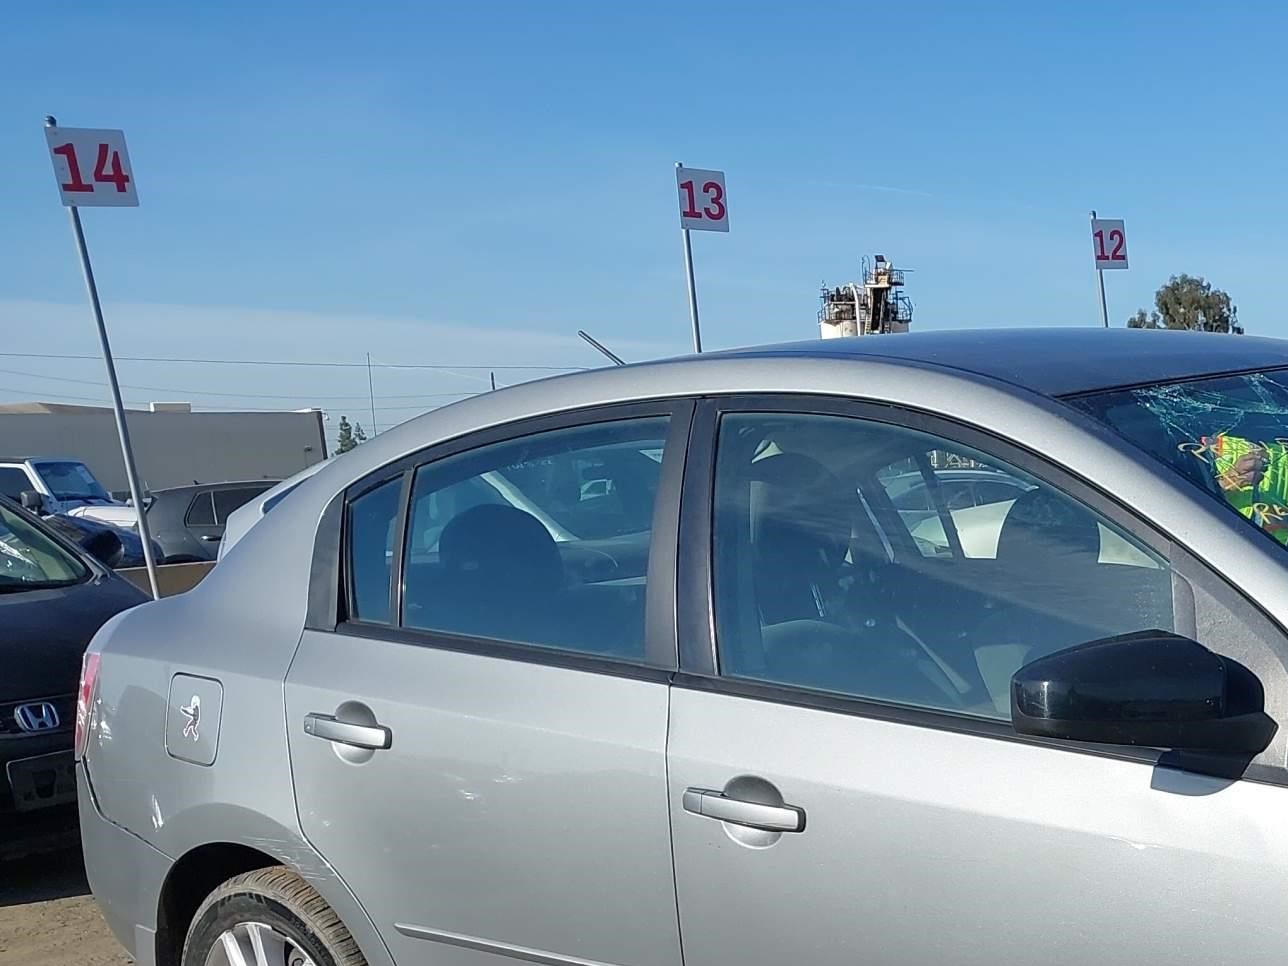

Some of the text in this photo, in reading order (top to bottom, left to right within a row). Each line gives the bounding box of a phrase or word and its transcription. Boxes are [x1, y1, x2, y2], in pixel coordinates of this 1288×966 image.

[53, 143, 130, 193] 14
[680, 180, 725, 220] 13
[1094, 229, 1126, 261] 12
